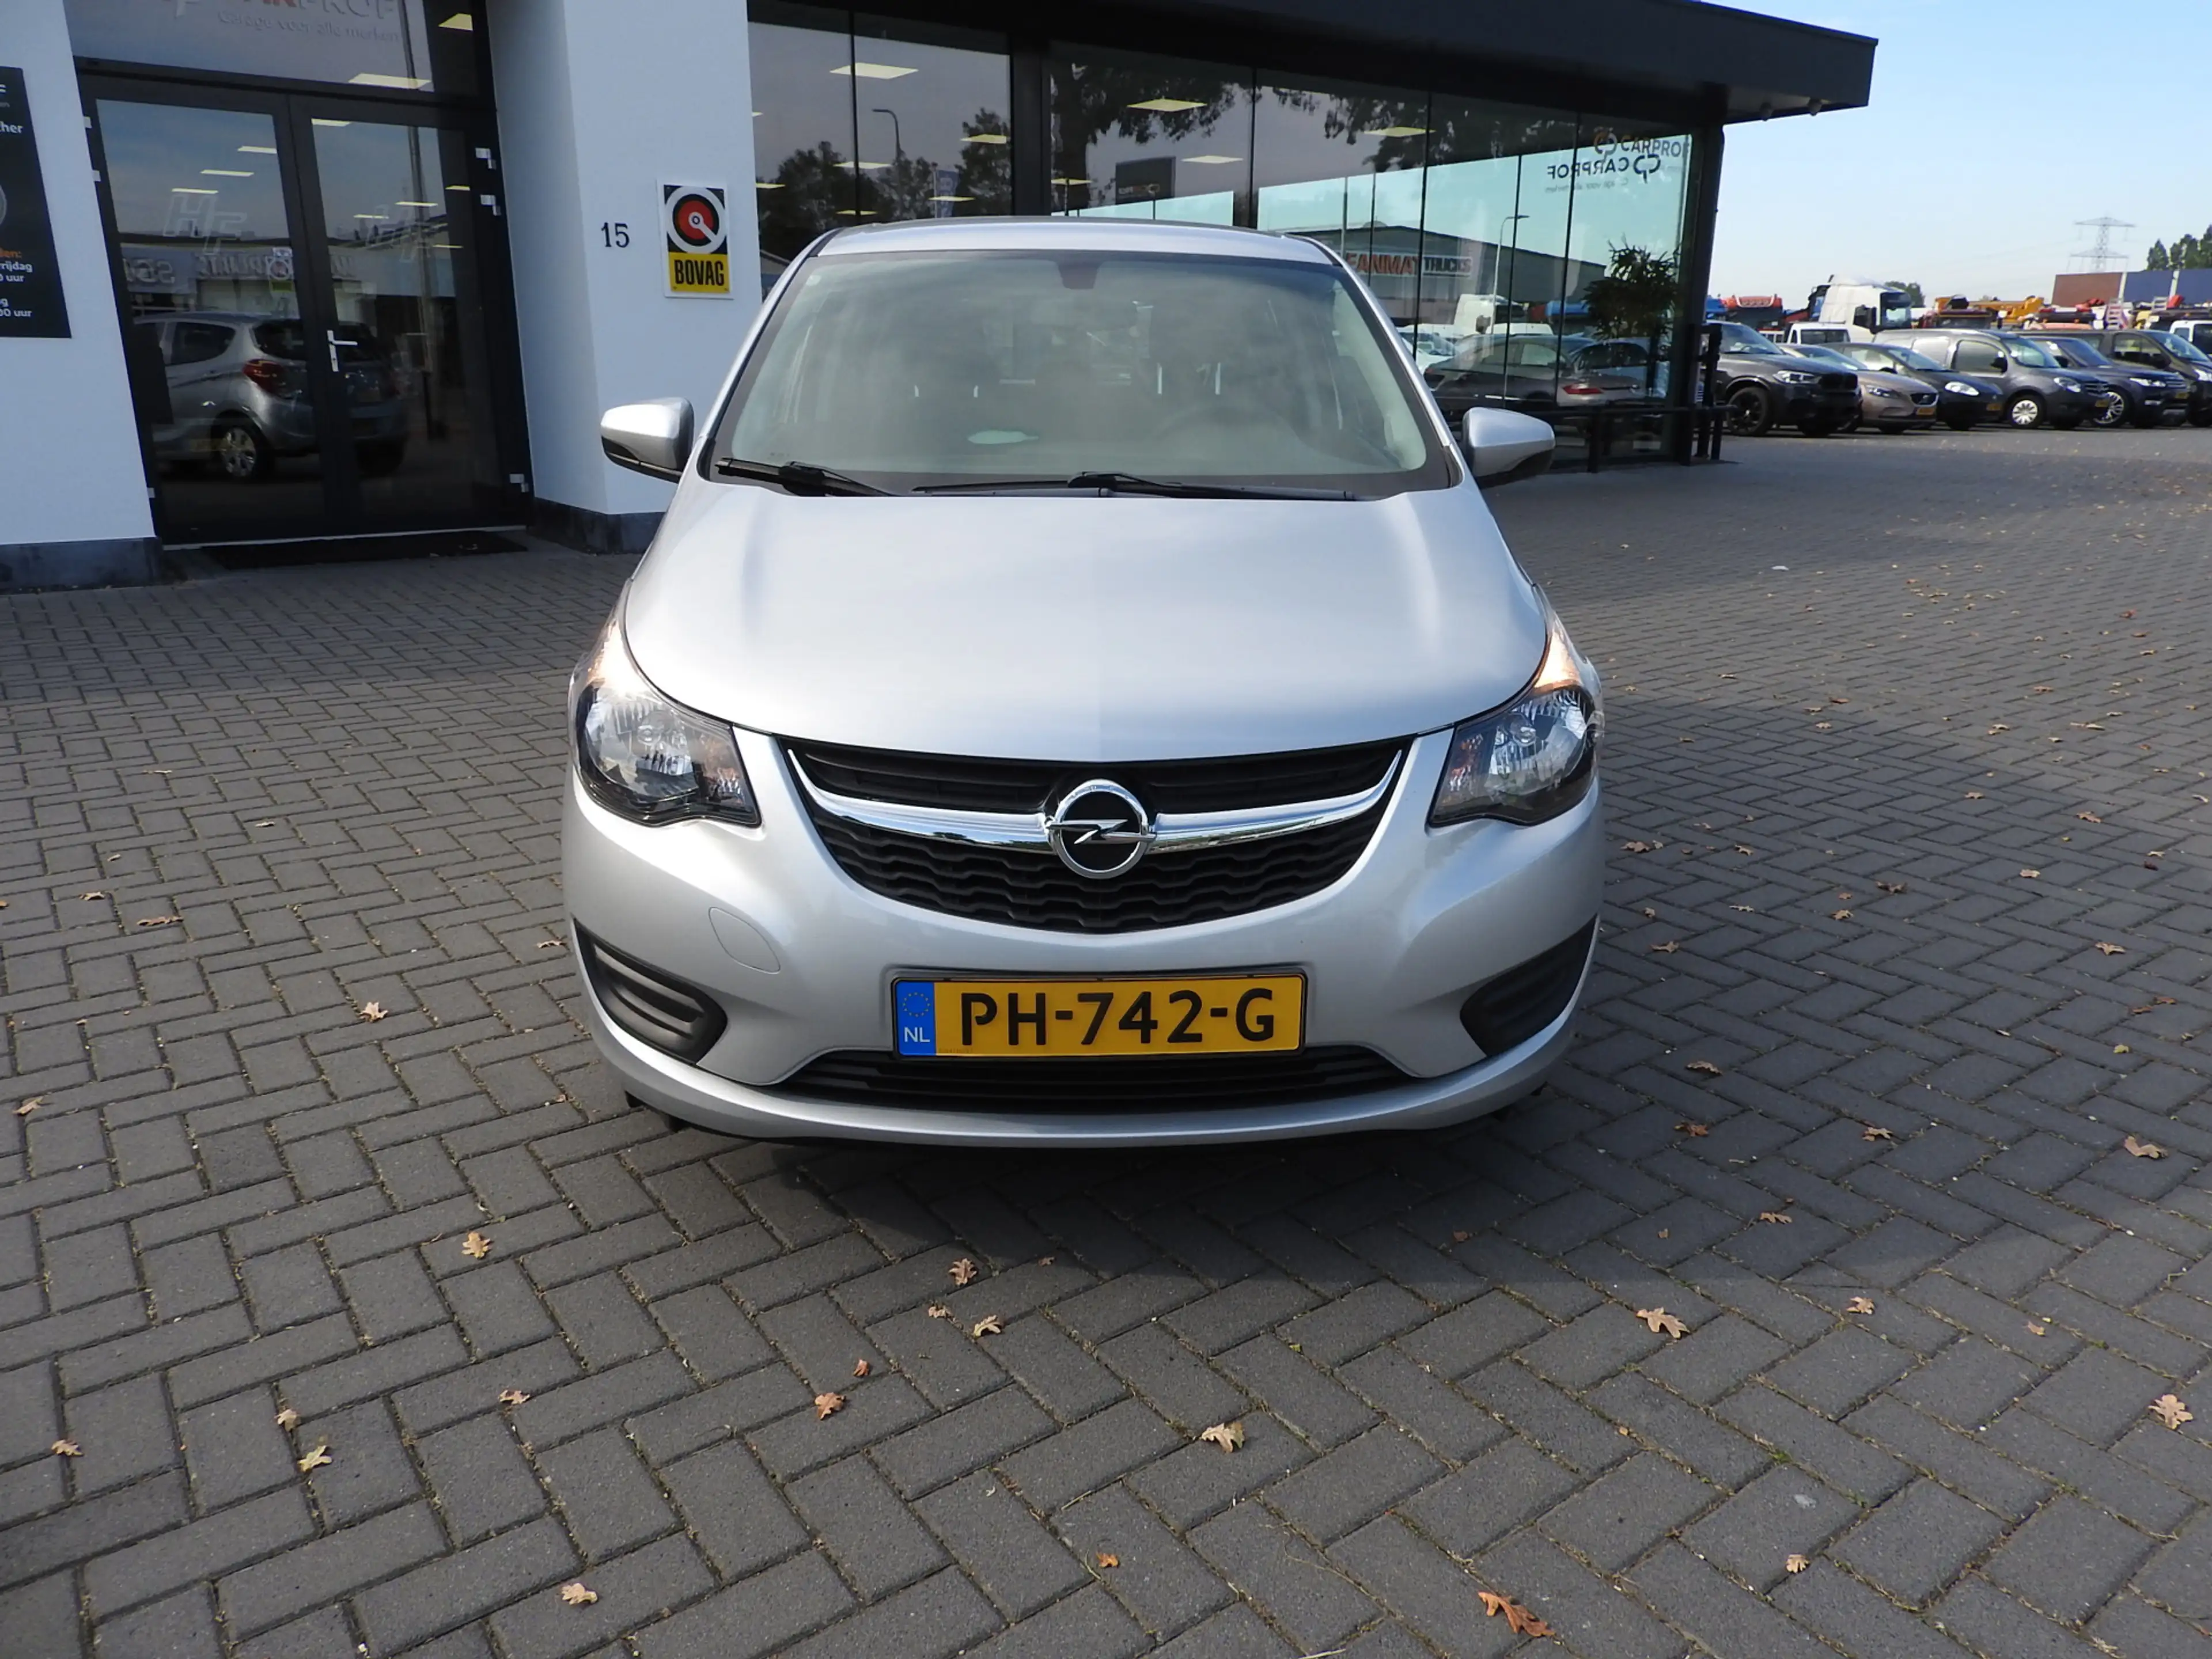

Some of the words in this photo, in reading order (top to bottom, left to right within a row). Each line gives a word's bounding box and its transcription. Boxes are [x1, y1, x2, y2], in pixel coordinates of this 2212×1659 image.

[601, 222, 630, 248] 15
[674, 259, 725, 286] BOVAG
[904, 1027, 930, 1043] NL
[960, 987, 1275, 1046] PH-742-G
